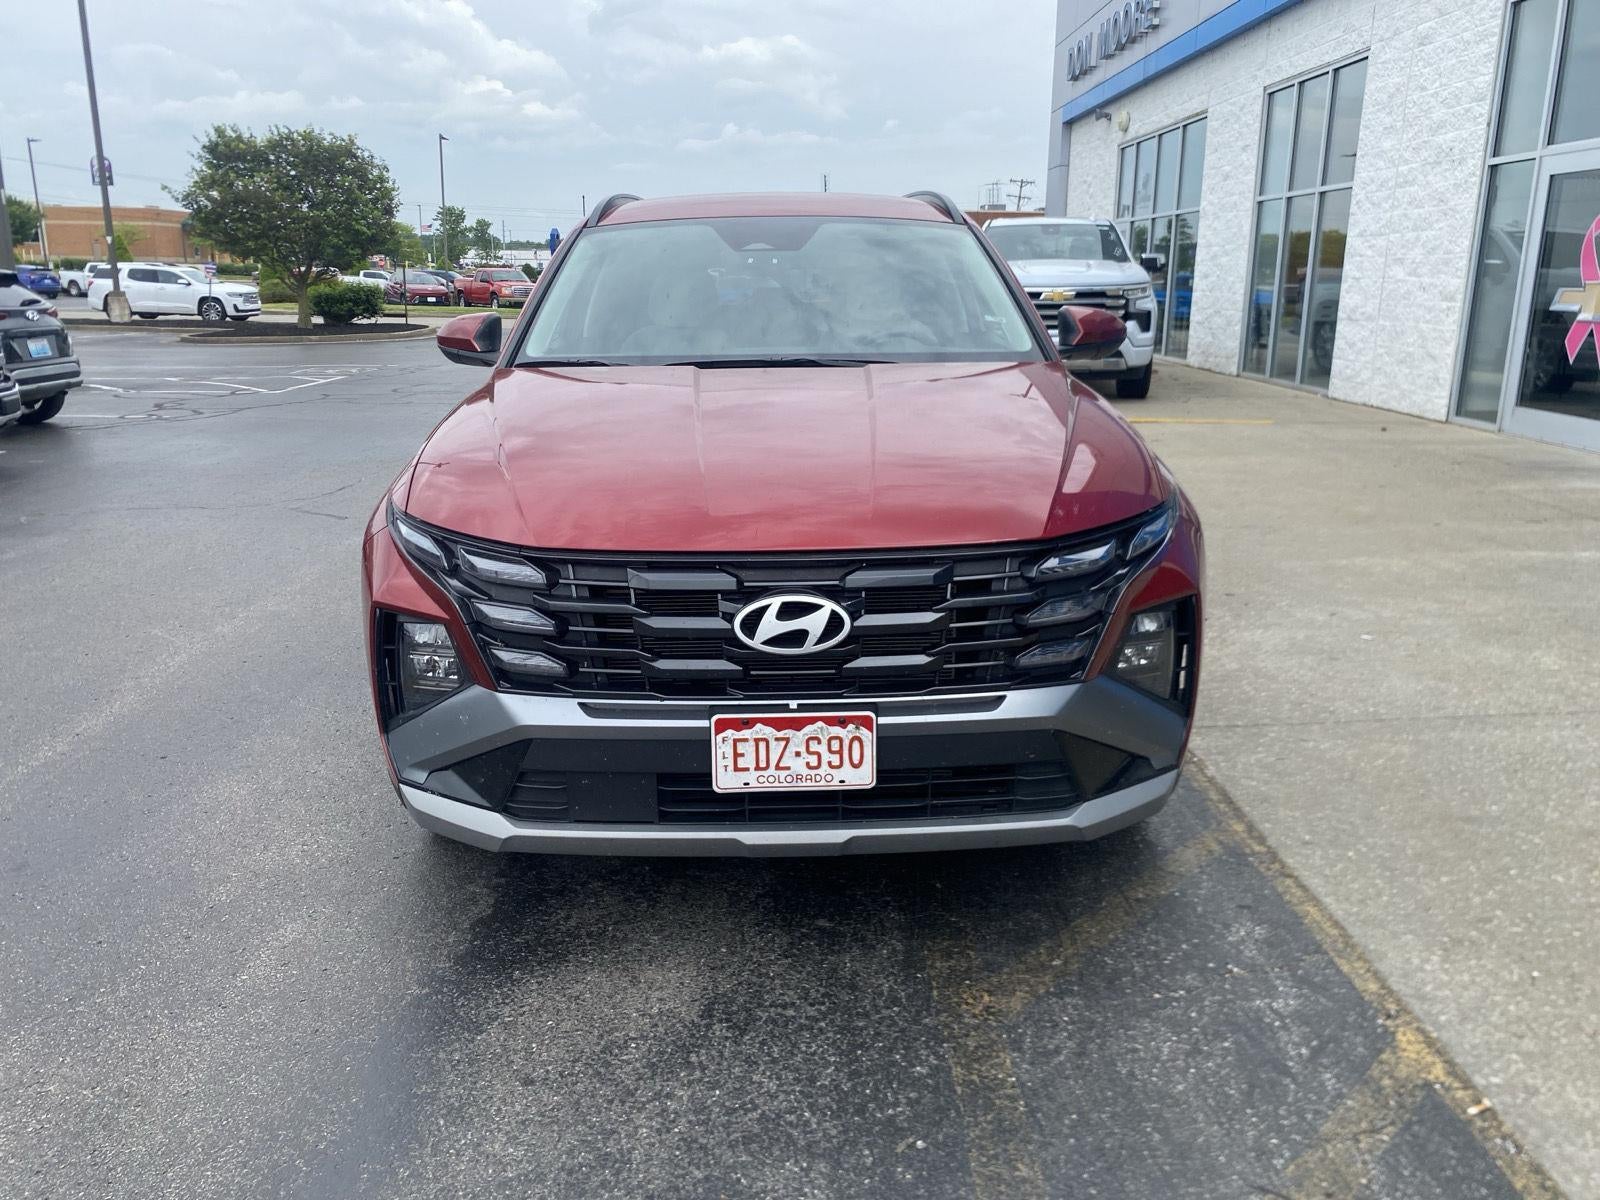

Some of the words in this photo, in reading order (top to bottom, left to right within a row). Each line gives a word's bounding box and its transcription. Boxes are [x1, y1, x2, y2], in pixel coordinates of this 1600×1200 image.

[1067, 32, 1097, 81] DON
[1099, 0, 1160, 60] MOORE
[756, 773, 834, 784] COLORADO
